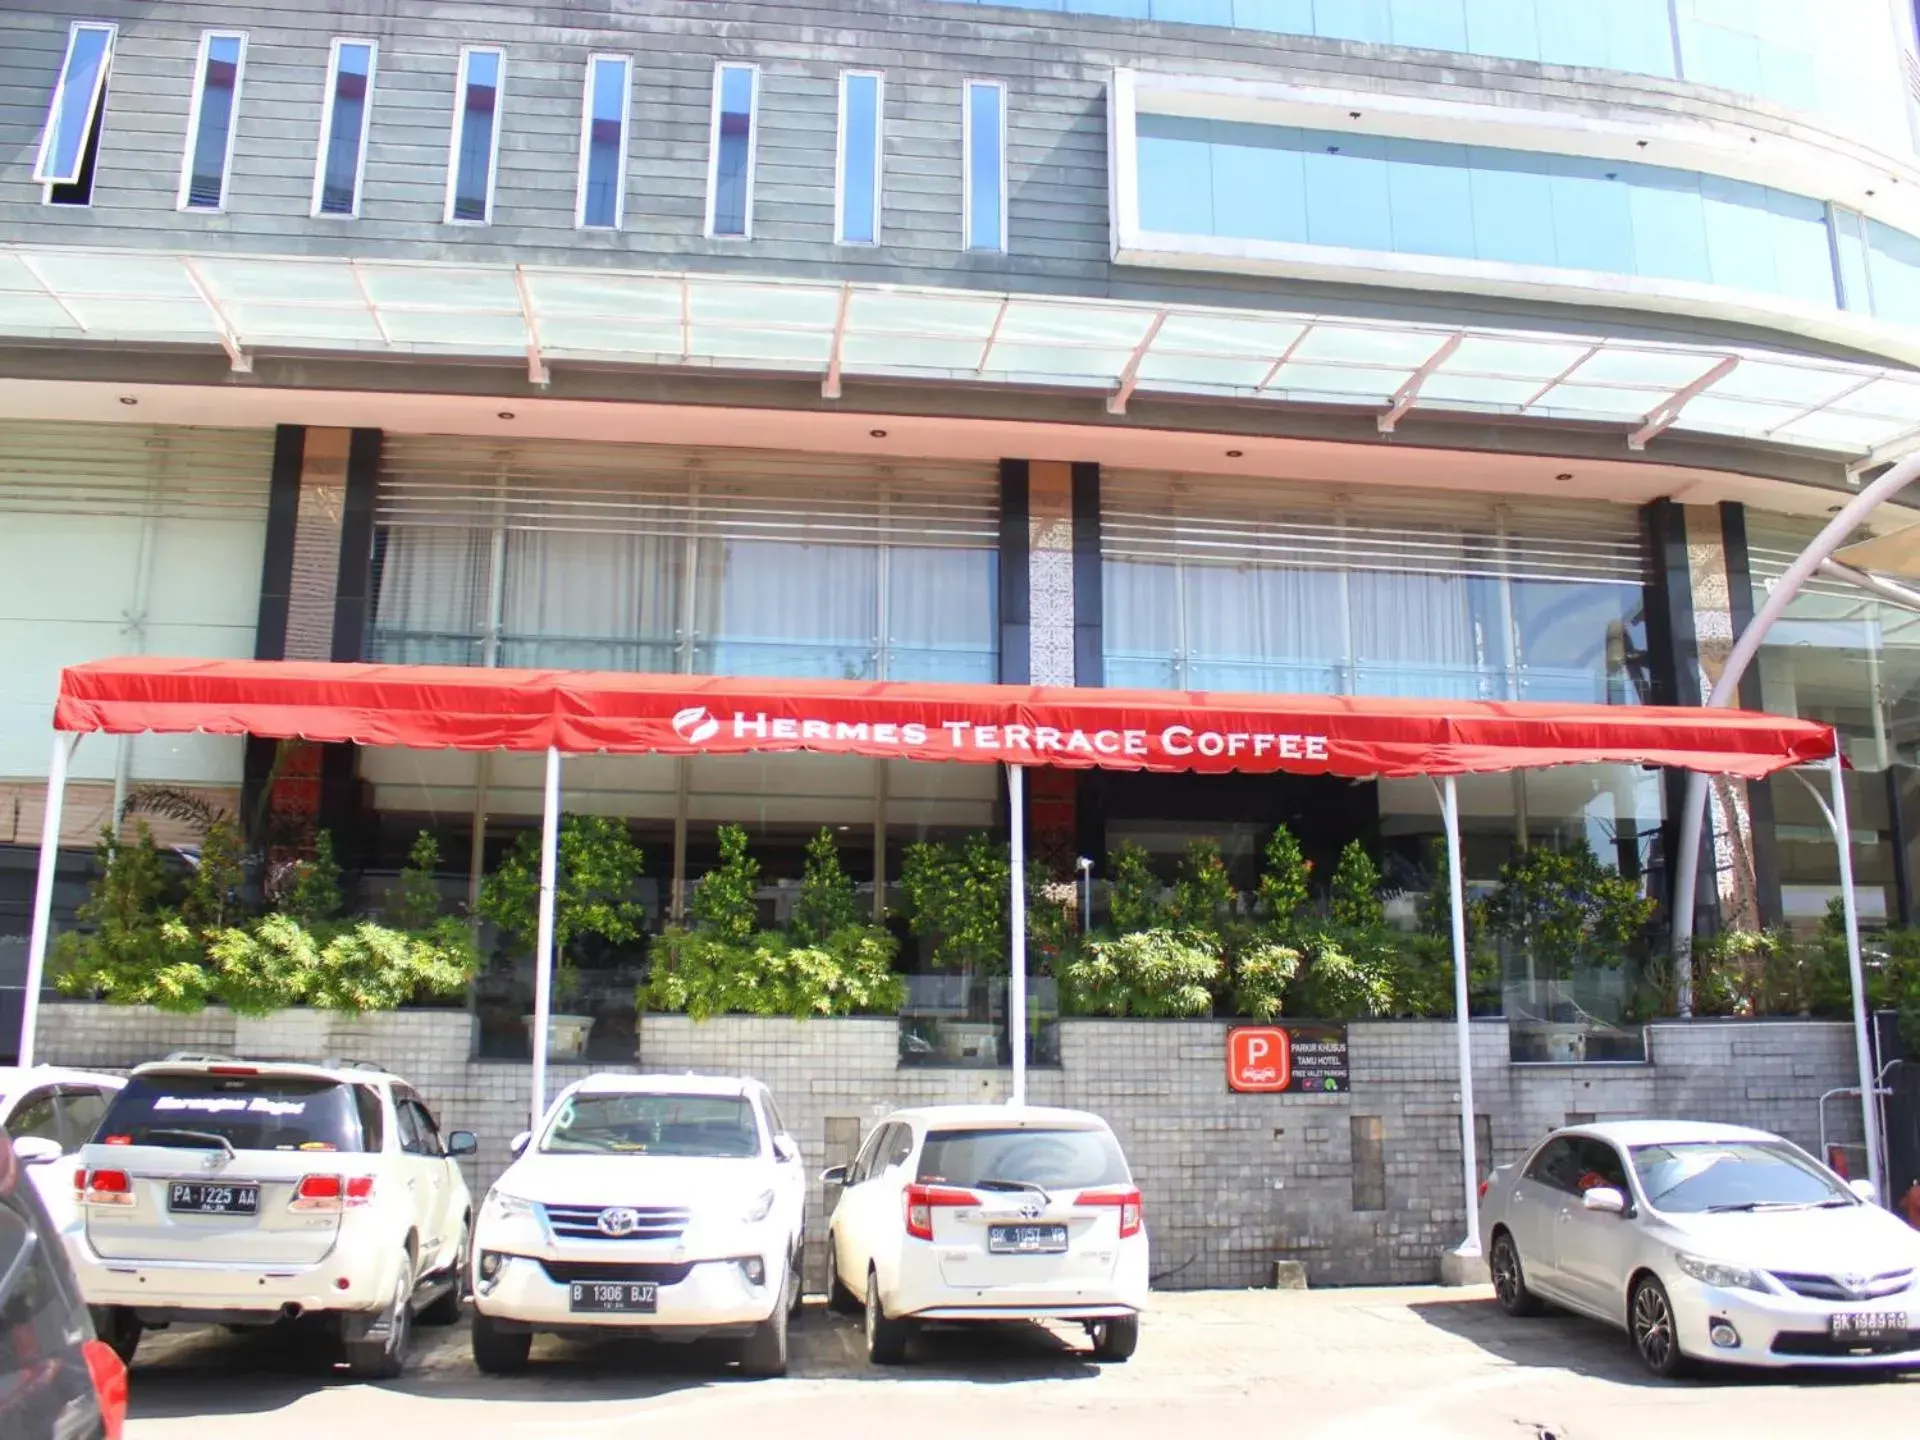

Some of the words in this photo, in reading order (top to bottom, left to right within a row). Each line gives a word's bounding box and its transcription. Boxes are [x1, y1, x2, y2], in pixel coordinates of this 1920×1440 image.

[733, 711, 927, 744] HERMES
[942, 720, 1148, 755] TERRACE
[1160, 725, 1330, 761] COFFEE
[1248, 1037, 1269, 1066] P
[1297, 1056, 1317, 1065] TAMU
[1318, 1056, 1341, 1065] HOTEL
[200, 1187, 232, 1204] 1225
[238, 1189, 256, 1205] AA
[573, 1284, 582, 1301] B
[593, 1284, 622, 1301] 1306
[631, 1285, 654, 1302] BJZ
